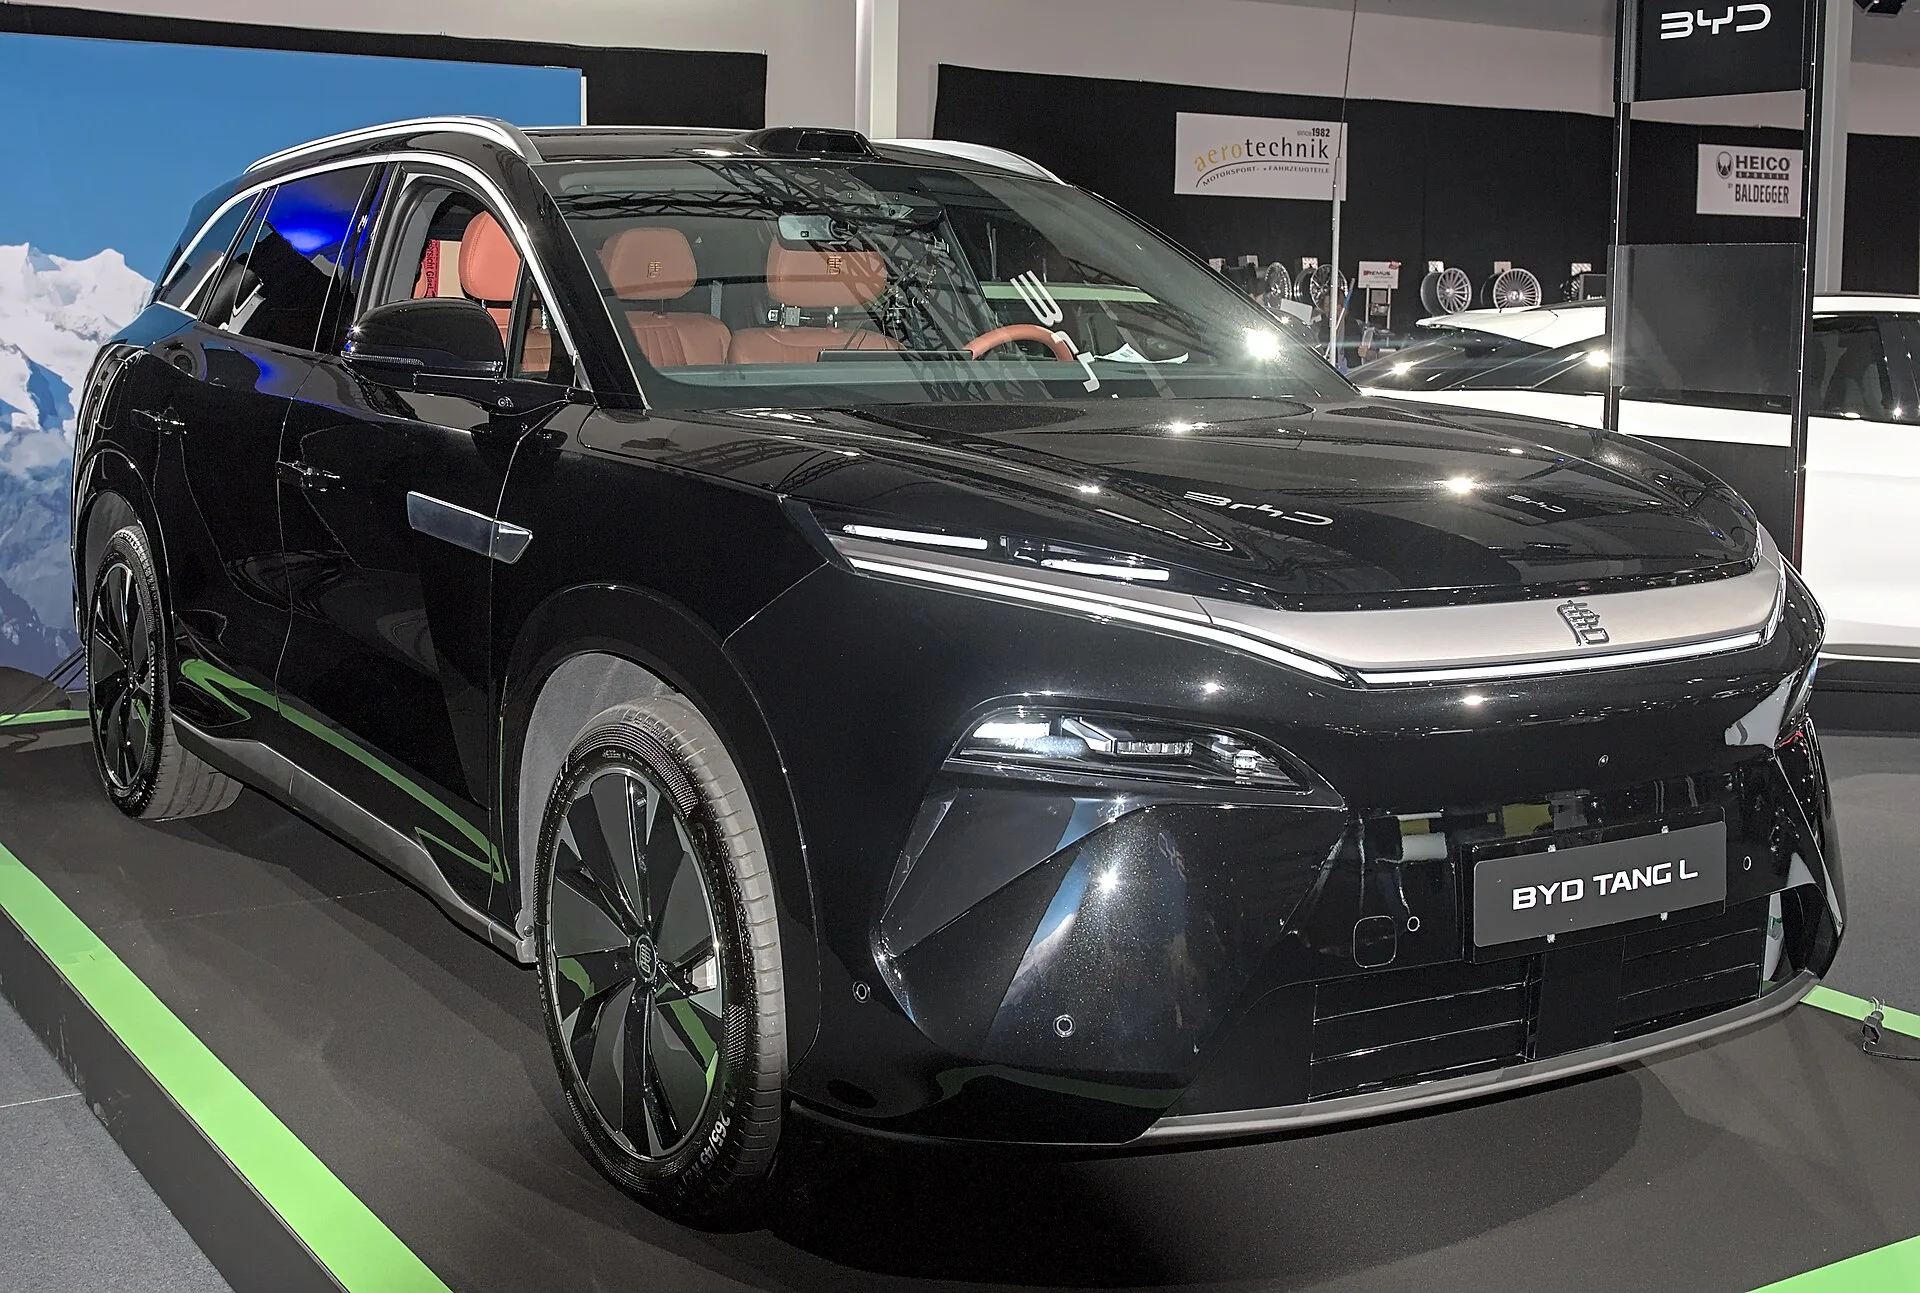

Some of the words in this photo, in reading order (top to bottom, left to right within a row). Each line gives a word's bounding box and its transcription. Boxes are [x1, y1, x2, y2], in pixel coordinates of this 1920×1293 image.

[1660, 3, 1772, 40] BYD
[1311, 127, 1331, 138] 1982
[1194, 137, 1329, 172] aerotechnik
[1735, 155, 1790, 171] HEICO
[1735, 184, 1789, 204] BALDEGGER
[1556, 599, 1610, 647] 唐
[1512, 878, 1584, 910] BYD
[1592, 862, 1672, 896] TANG
[1678, 859, 1698, 880] L
